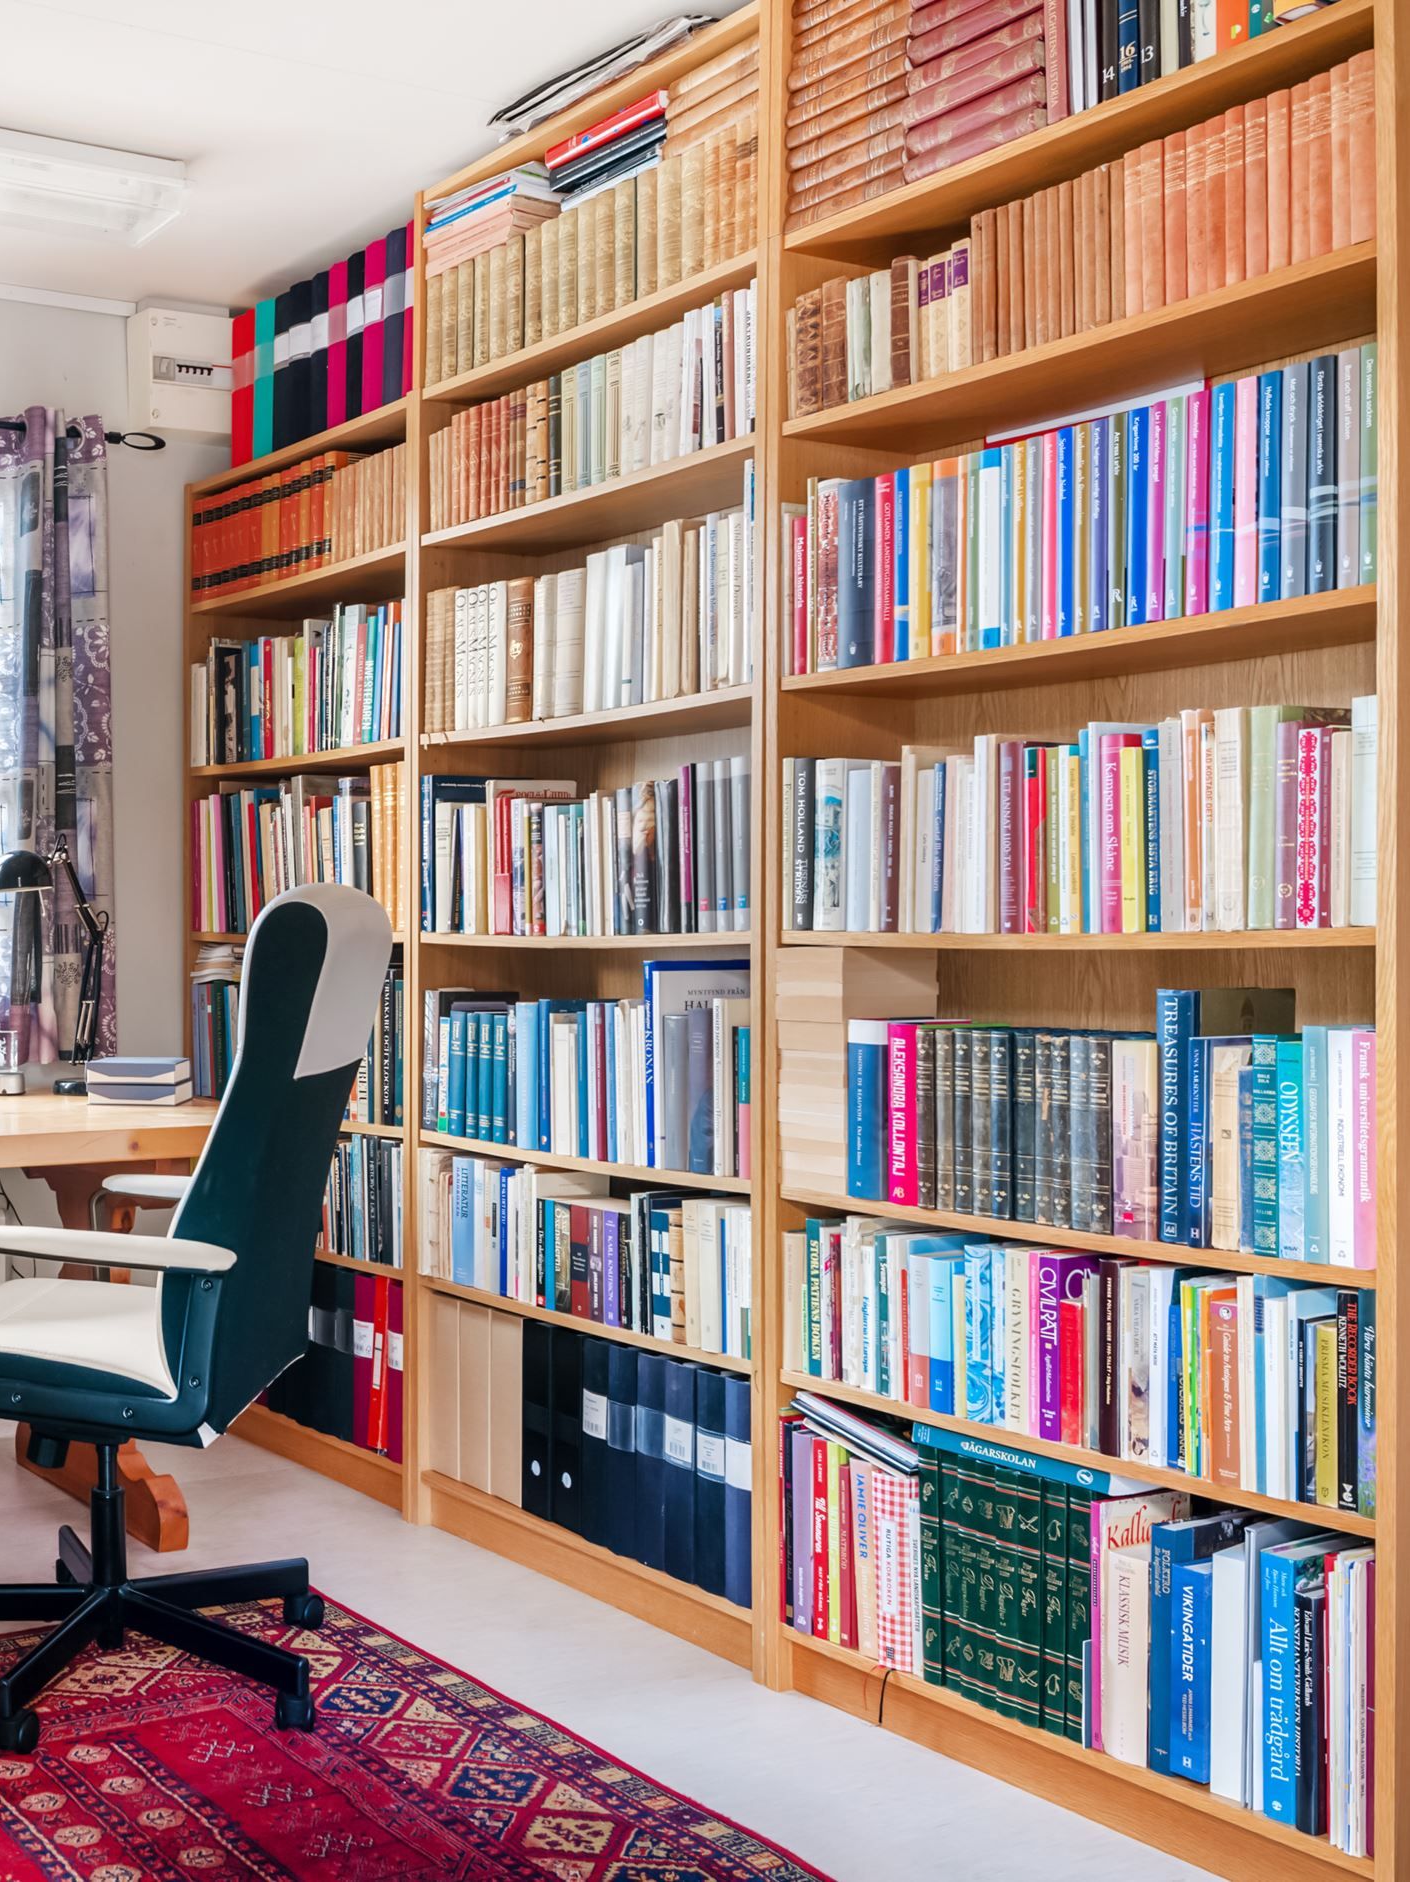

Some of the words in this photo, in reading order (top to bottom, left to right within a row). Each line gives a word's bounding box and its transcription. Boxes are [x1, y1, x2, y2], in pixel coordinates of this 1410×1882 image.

[1119, 41, 1136, 60] 16
[1141, 45, 1154, 64] 13
[1050, 60, 1059, 108] HISTORIA
[1102, 65, 1115, 84] 14
[1316, 370, 1325, 391] Första
[1365, 358, 1374, 372] Den
[1263, 385, 1273, 409] Hyllade
[1289, 377, 1297, 391] Mat
[1289, 391, 1297, 403] och
[1344, 381, 1352, 392] och
[1365, 373, 1373, 398] svenska
[1287, 404, 1297, 423] dryck
[1315, 391, 1325, 430] världskriget
[1344, 393, 1352, 412] straff
[1365, 399, 1374, 428] socknen
[1263, 410, 1272, 436] kroppar
[1316, 458, 1324, 475] arkiv
[796, 536, 804, 575] Majornas
[796, 576, 804, 608] historia
[362, 660, 375, 730] INVESTERAREN
[798, 771, 806, 796] TOM
[1003, 776, 1011, 796] ETT
[1103, 762, 1117, 812] Kampen
[1003, 796, 1011, 830] ANNAT
[1147, 768, 1158, 840] STORMAKTENS
[422, 820, 430, 860] human
[797, 800, 806, 853] HOLLAND
[1105, 814, 1115, 834] om
[1106, 836, 1118, 871] Skåne
[1148, 841, 1157, 868] SISTA
[794, 858, 802, 904] STRIDEN
[1148, 869, 1158, 895] KRIG
[727, 986, 745, 995] FRÅN
[645, 1030, 654, 1084] KRONAN
[1163, 997, 1178, 1105] TREASURES
[1359, 1041, 1371, 1079] Fransk
[891, 1037, 906, 1108] ALEKSANDRA
[1163, 1111, 1178, 1136] OF
[1336, 1118, 1344, 1163] INDUSTRIELL
[892, 1111, 905, 1176] KOLLONTAJ
[1190, 1121, 1204, 1181] HÄSTENS
[1357, 1082, 1371, 1203] universitetsgrammatik
[460, 1167, 469, 1218] LITTERATUR
[1163, 1140, 1178, 1216] BRITAIN
[1337, 1163, 1345, 1197] EKONOMI
[1189, 1184, 1202, 1208] TID
[554, 1207, 563, 1272] Oxenstierna
[810, 1239, 821, 1276] STORA
[879, 1262, 889, 1295] Svampar
[811, 1276, 821, 1322] PATIENS
[862, 1295, 870, 1335] Fåglarna
[1039, 1266, 1058, 1346] CIVILRÄTT
[1347, 1302, 1357, 1321] THE
[811, 1322, 822, 1361] BOKEN
[1222, 1332, 1232, 1354] Guide
[1338, 1315, 1347, 1352] KENNETH
[1347, 1323, 1357, 1374] RECORDER
[1364, 1325, 1375, 1350] Våra
[862, 1340, 870, 1373] Europa
[1010, 1287, 1023, 1424] GRYNINGSFOLKET
[1222, 1354, 1231, 1362] to
[1320, 1338, 1330, 1377] PRISMA
[1338, 1353, 1347, 1388] WOLLITZ
[1364, 1352, 1375, 1379] bästa
[1221, 1362, 1232, 1392] Antiques
[1347, 1375, 1357, 1406] BOOK
[1223, 1399, 1232, 1417] Fine
[1320, 1380, 1330, 1459] MUSIKLEXIKON
[1364, 1380, 1375, 1428] barnvisor
[1222, 1417, 1232, 1432] Arts
[815, 1496, 827, 1512] Till
[856, 1473, 867, 1510] JAMIE
[815, 1512, 826, 1553] Sommaren
[840, 1528, 848, 1569] MATBRÖD
[857, 1512, 868, 1558] OLIVER
[912, 1539, 920, 1565] SVERIGES
[912, 1566, 920, 1578] NYA
[1161, 1548, 1172, 1594] FOLKTRO
[1117, 1574, 1132, 1627] KLASSISK
[1181, 1584, 1194, 1682] VIKINGATIDER
[1269, 1617, 1289, 1655] Allt
[1303, 1610, 1313, 1635] Edward
[1117, 1629, 1130, 1668] MUSIK
[1269, 1658, 1283, 1691] om
[1265, 1696, 1290, 1782] trädgård
